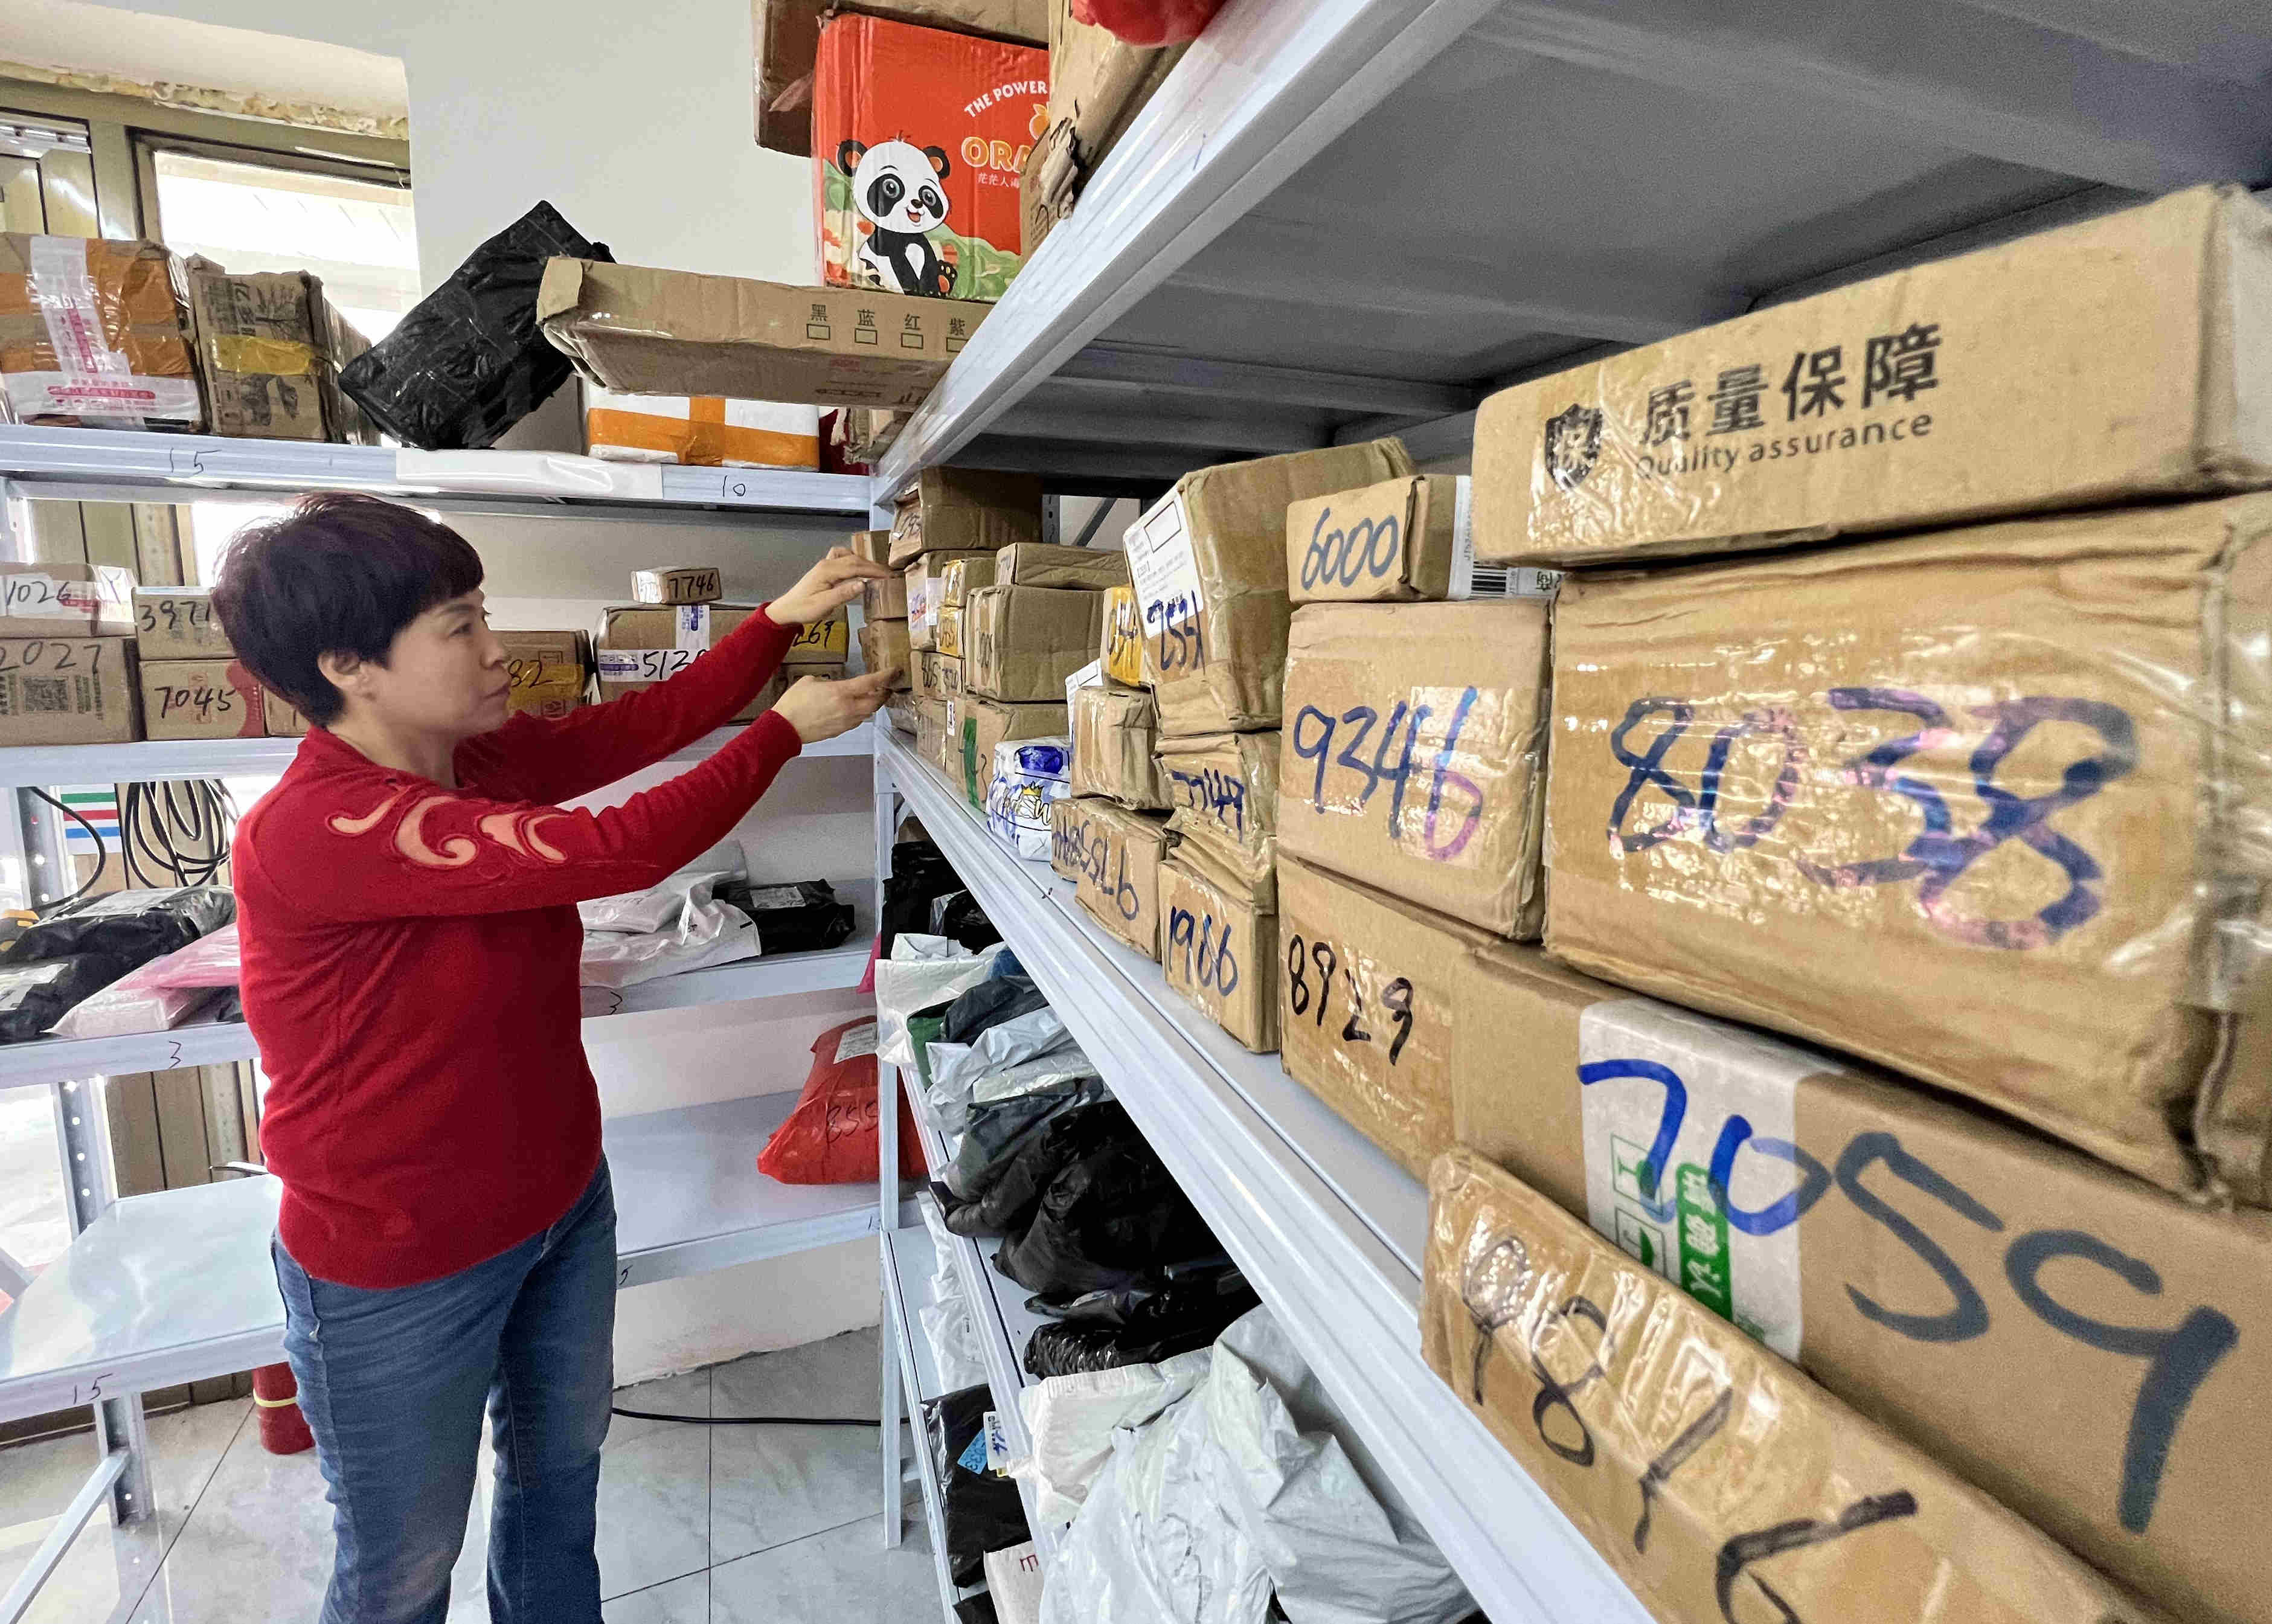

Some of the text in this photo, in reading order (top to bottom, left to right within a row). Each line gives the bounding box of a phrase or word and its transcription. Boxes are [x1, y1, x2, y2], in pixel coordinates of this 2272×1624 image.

[964, 80, 1048, 118] THE POWER
[811, 304, 966, 336] 黑 蓝 红 紫
[1639, 322, 1943, 451] 质量保障
[1636, 444, 1741, 481] Quality
[1748, 413, 1934, 463] assurance
[722, 475, 747, 498] 10
[1300, 507, 1399, 591] 6000
[6, 580, 71, 606] 1026
[669, 573, 715, 599] 7746
[154, 686, 236, 719] 7045
[1293, 685, 1484, 862] 9346
[1606, 686, 2139, 951] 8038
[168, 1040, 183, 1069] 3
[1576, 1057, 2239, 1535] 7059
[72, 1372, 115, 1406] 15
